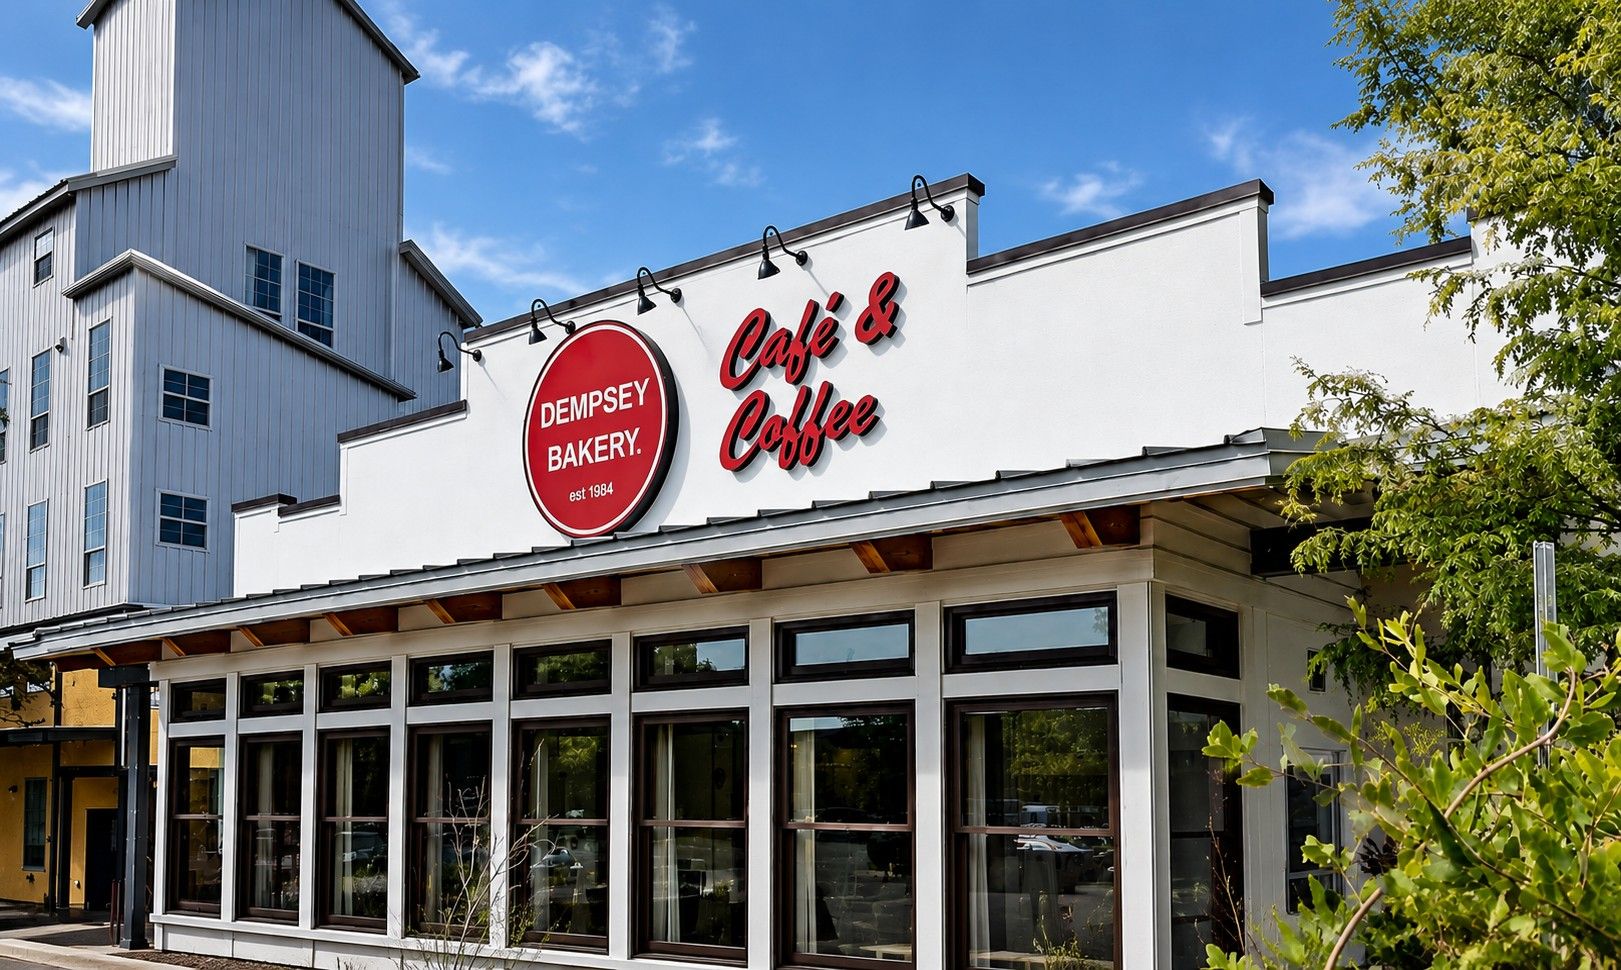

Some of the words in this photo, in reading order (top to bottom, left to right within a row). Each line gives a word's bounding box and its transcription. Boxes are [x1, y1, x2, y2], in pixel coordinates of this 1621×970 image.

[720, 291, 843, 391] Café
[855, 271, 899, 345] &
[540, 377, 650, 429] DEMPSEY
[719, 380, 879, 472] Coffee
[547, 427, 642, 472] BAKERY.
[569, 486, 586, 502] est
[588, 481, 614, 498] 1984
